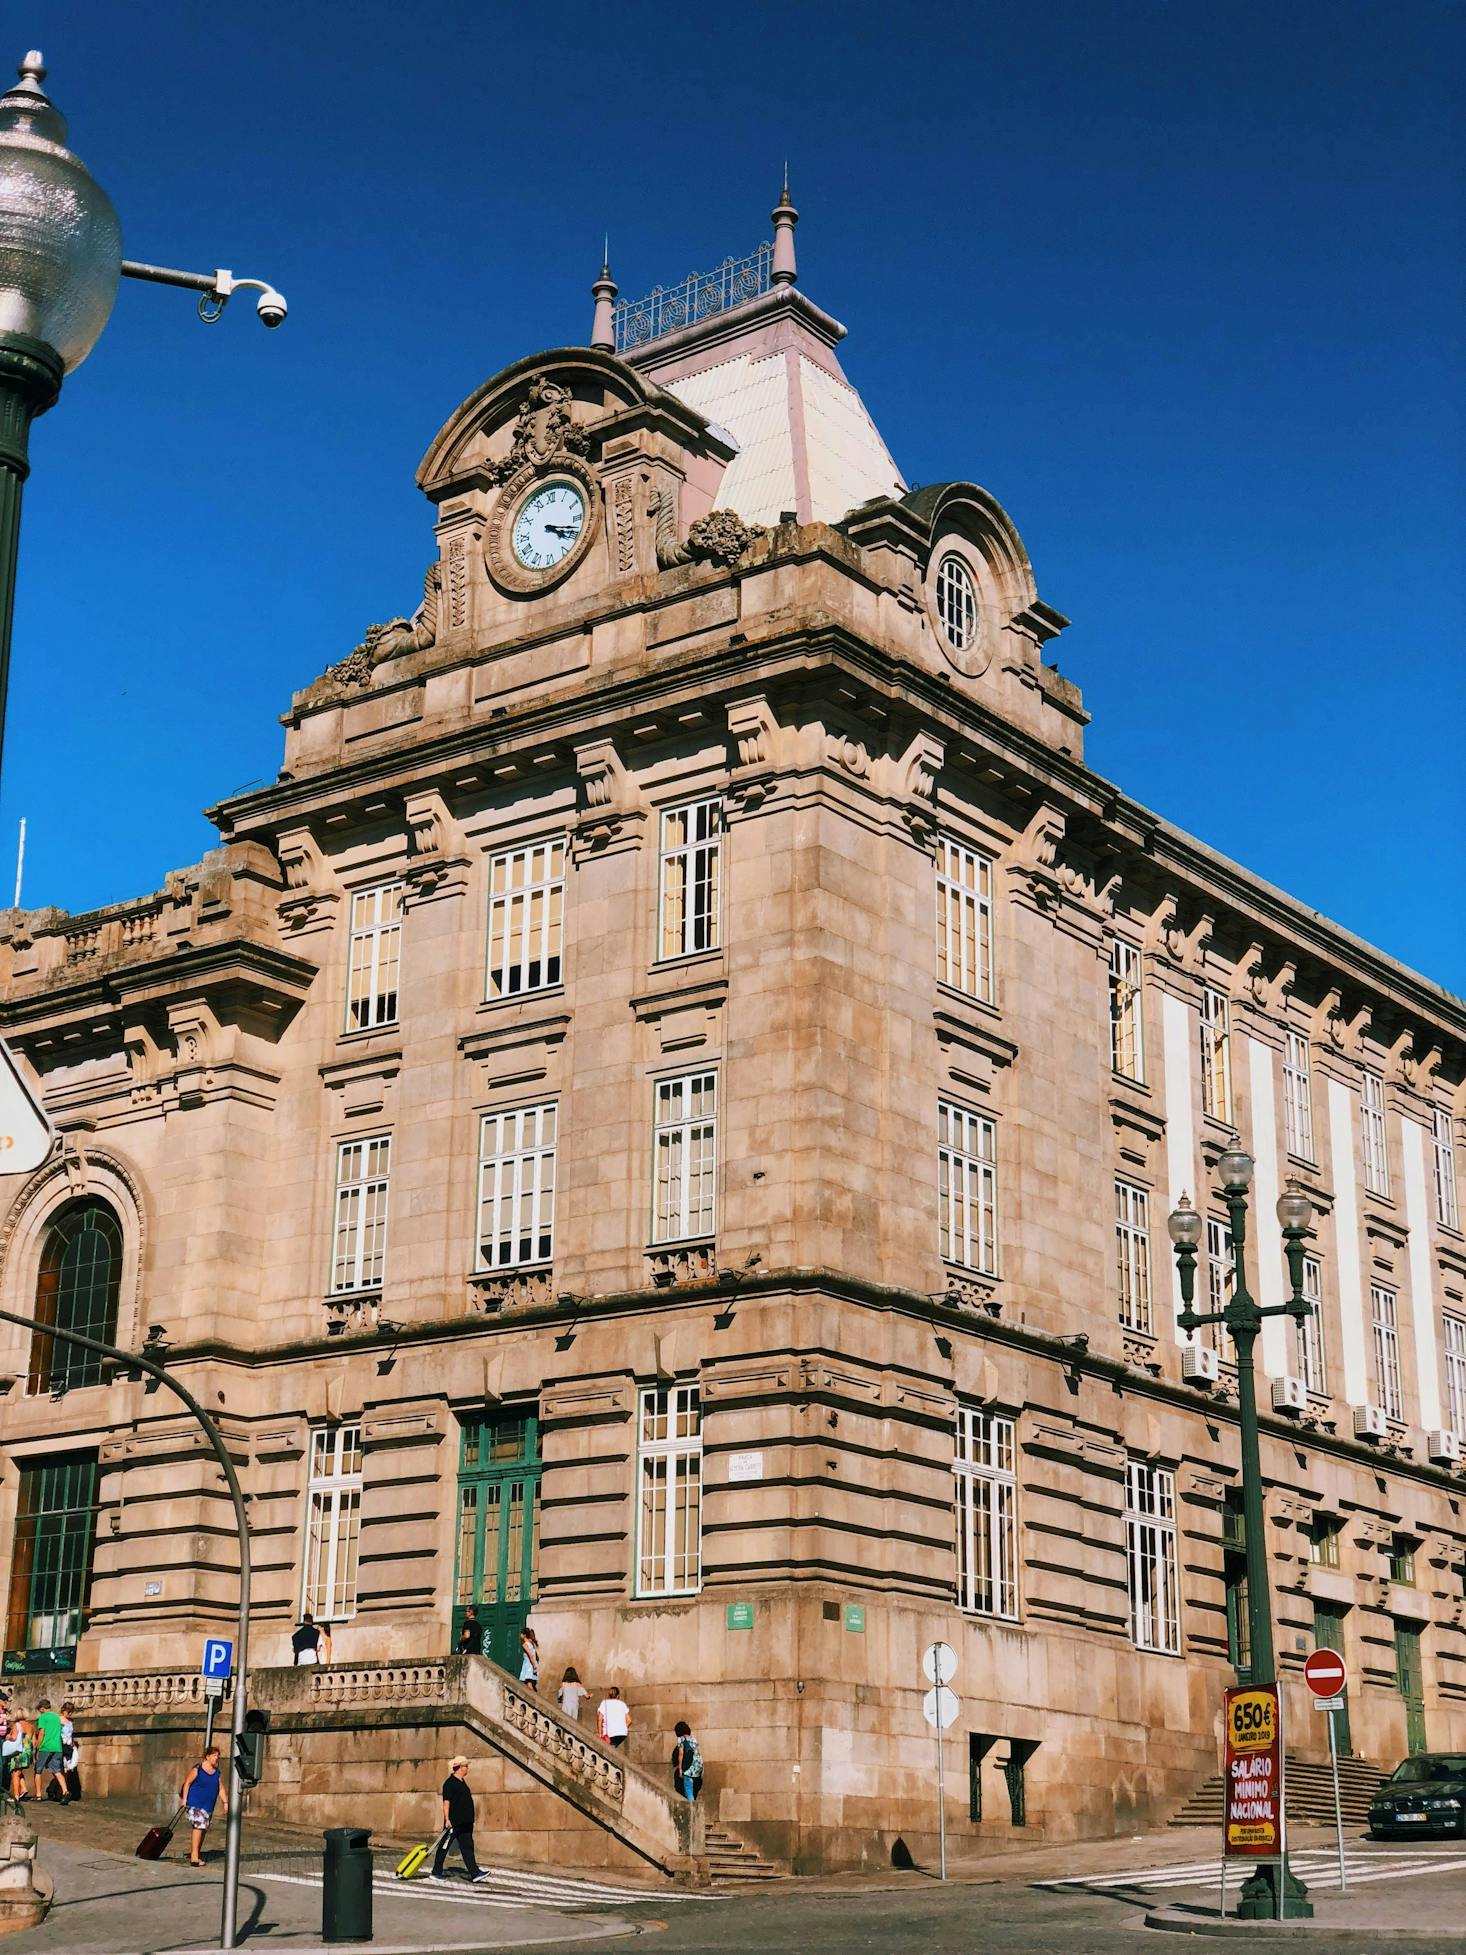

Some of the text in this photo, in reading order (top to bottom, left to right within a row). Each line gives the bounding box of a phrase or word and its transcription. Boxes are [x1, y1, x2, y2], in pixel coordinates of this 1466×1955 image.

[546, 491, 556, 505] XII
[560, 490, 568, 502] I
[533, 500, 544, 512] XI
[568, 499, 578, 510] II
[523, 517, 534, 526] X
[520, 531, 530, 543] IX
[521, 543, 534, 560] VIII
[531, 552, 542, 566] VII
[546, 553, 555, 565] VI
[209, 1644, 226, 1673] P
[1234, 1702, 1271, 1732] 650€
[1258, 1730, 1271, 1741] 2019
[1231, 1753, 1272, 1779] SALÁRIO
[1234, 1777, 1269, 1800] MÍNIMO
[1230, 1800, 1275, 1819] NACIONAL
